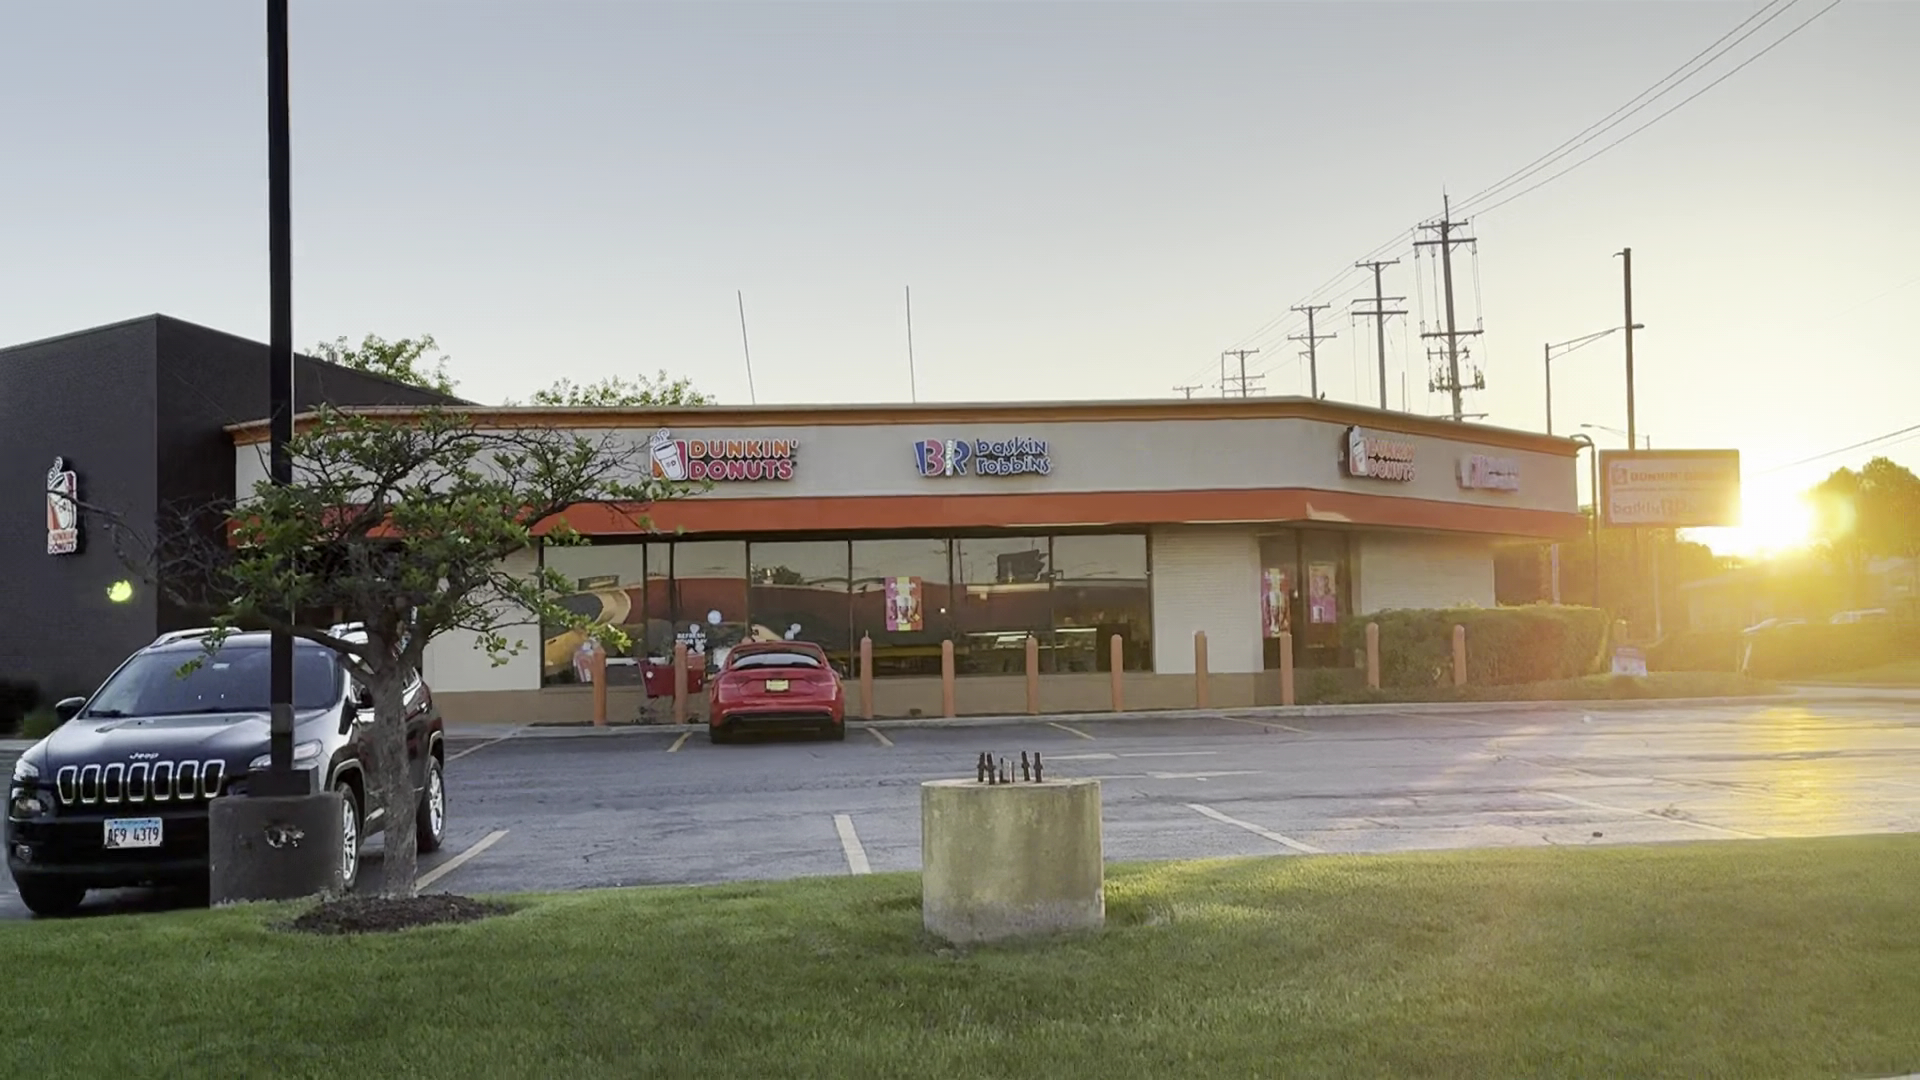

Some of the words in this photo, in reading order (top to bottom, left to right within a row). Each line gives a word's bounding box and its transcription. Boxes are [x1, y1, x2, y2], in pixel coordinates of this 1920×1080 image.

[689, 438, 799, 459] DUNKIN'
[976, 436, 1049, 456] baskin
[689, 459, 793, 480] DONUTS
[976, 456, 1051, 475] robbins
[1368, 458, 1416, 482] DONUTS
[129, 752, 159, 760] Jeep
